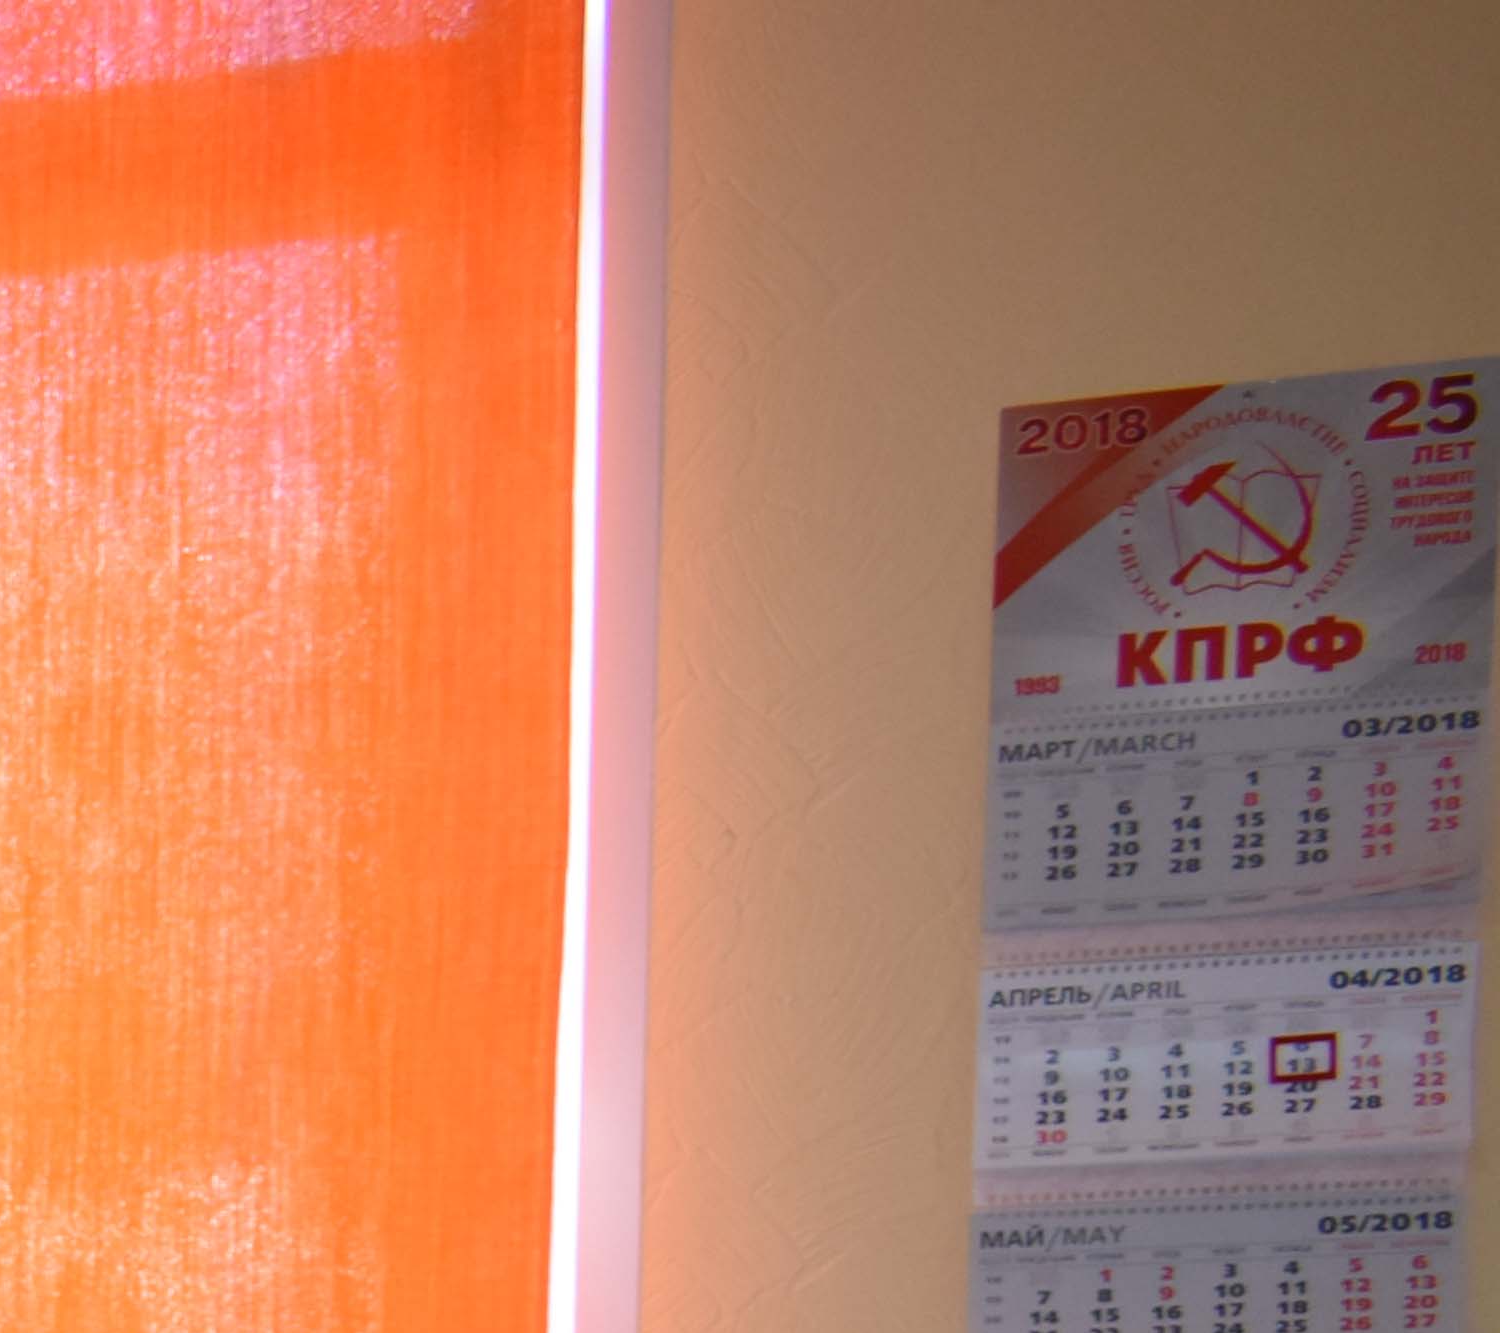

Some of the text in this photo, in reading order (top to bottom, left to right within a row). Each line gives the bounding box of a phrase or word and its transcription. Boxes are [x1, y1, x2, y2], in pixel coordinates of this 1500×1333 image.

[1364, 373, 1478, 441] 25
[1015, 406, 1150, 455] 2018
[1411, 441, 1477, 465] ЛЕТ
[1116, 615, 1366, 689] КПРФ
[1415, 642, 1467, 666] 2018
[1013, 674, 1062, 697] 1993
[1341, 710, 1481, 738] 03/2018
[1245, 770, 1259, 786] 1
[1307, 765, 1323, 782] 2
[1373, 760, 1388, 777] 3
[1437, 755, 1455, 771] 4
[1056, 803, 1071, 820] 5
[1116, 799, 1134, 816] 6
[1179, 794, 1196, 812] 7
[1306, 786, 1324, 803] 9
[1364, 780, 1397, 799] 10
[1431, 774, 1463, 792] 11
[1047, 823, 1077, 841] 12
[1109, 819, 1139, 837] 13
[1171, 815, 1203, 833] 14
[1235, 811, 1266, 828] 15
[1298, 806, 1331, 824] 16
[1363, 800, 1396, 818] 17
[1047, 815, 1460, 861] 19 20 21 22 23 24 25
[1045, 841, 1394, 882] 26 27 28 29 30 31
[1328, 963, 1468, 990] 04/2018
[1425, 1009, 1438, 1025] 1
[1045, 1048, 1060, 1066] 2
[1107, 1045, 1122, 1063] 3
[1167, 1043, 1184, 1059] 4
[1231, 1039, 1247, 1056] 5
[1358, 1032, 1376, 1050] 7
[1043, 1070, 1061, 1086] 9
[1099, 1066, 1131, 1083] 10
[1160, 1063, 1191, 1079] 11
[1223, 1060, 1253, 1076] 12
[1350, 1053, 1383, 1070] 14
[1415, 1050, 1447, 1068] 15
[1037, 1089, 1068, 1106] 16
[1098, 1087, 1129, 1103] 17
[1162, 1083, 1193, 1100] 18
[1222, 1081, 1254, 1097] 19
[1348, 1074, 1380, 1091] 21
[1413, 1071, 1447, 1088] 22
[1035, 1091, 1447, 1126] 23 24 25 26 27 28 29
[1036, 1129, 1068, 1146] 30
[1318, 1210, 1454, 1235] 05/2018
[1099, 1254, 1429, 1283] 1 2 3 4 5 6
[1037, 1290, 1053, 1305] 7
[1158, 1285, 1176, 1301] 9
[1214, 1282, 1247, 1299] 10
[1277, 1280, 1307, 1296] 11
[1340, 1277, 1372, 1294] 12
[1405, 1274, 1438, 1291] 13
[1029, 1294, 1439, 1325] 14 15 16 17 18 19 20
[1339, 1315, 1373, 1332] 26
[1404, 1313, 1437, 1329] 27
